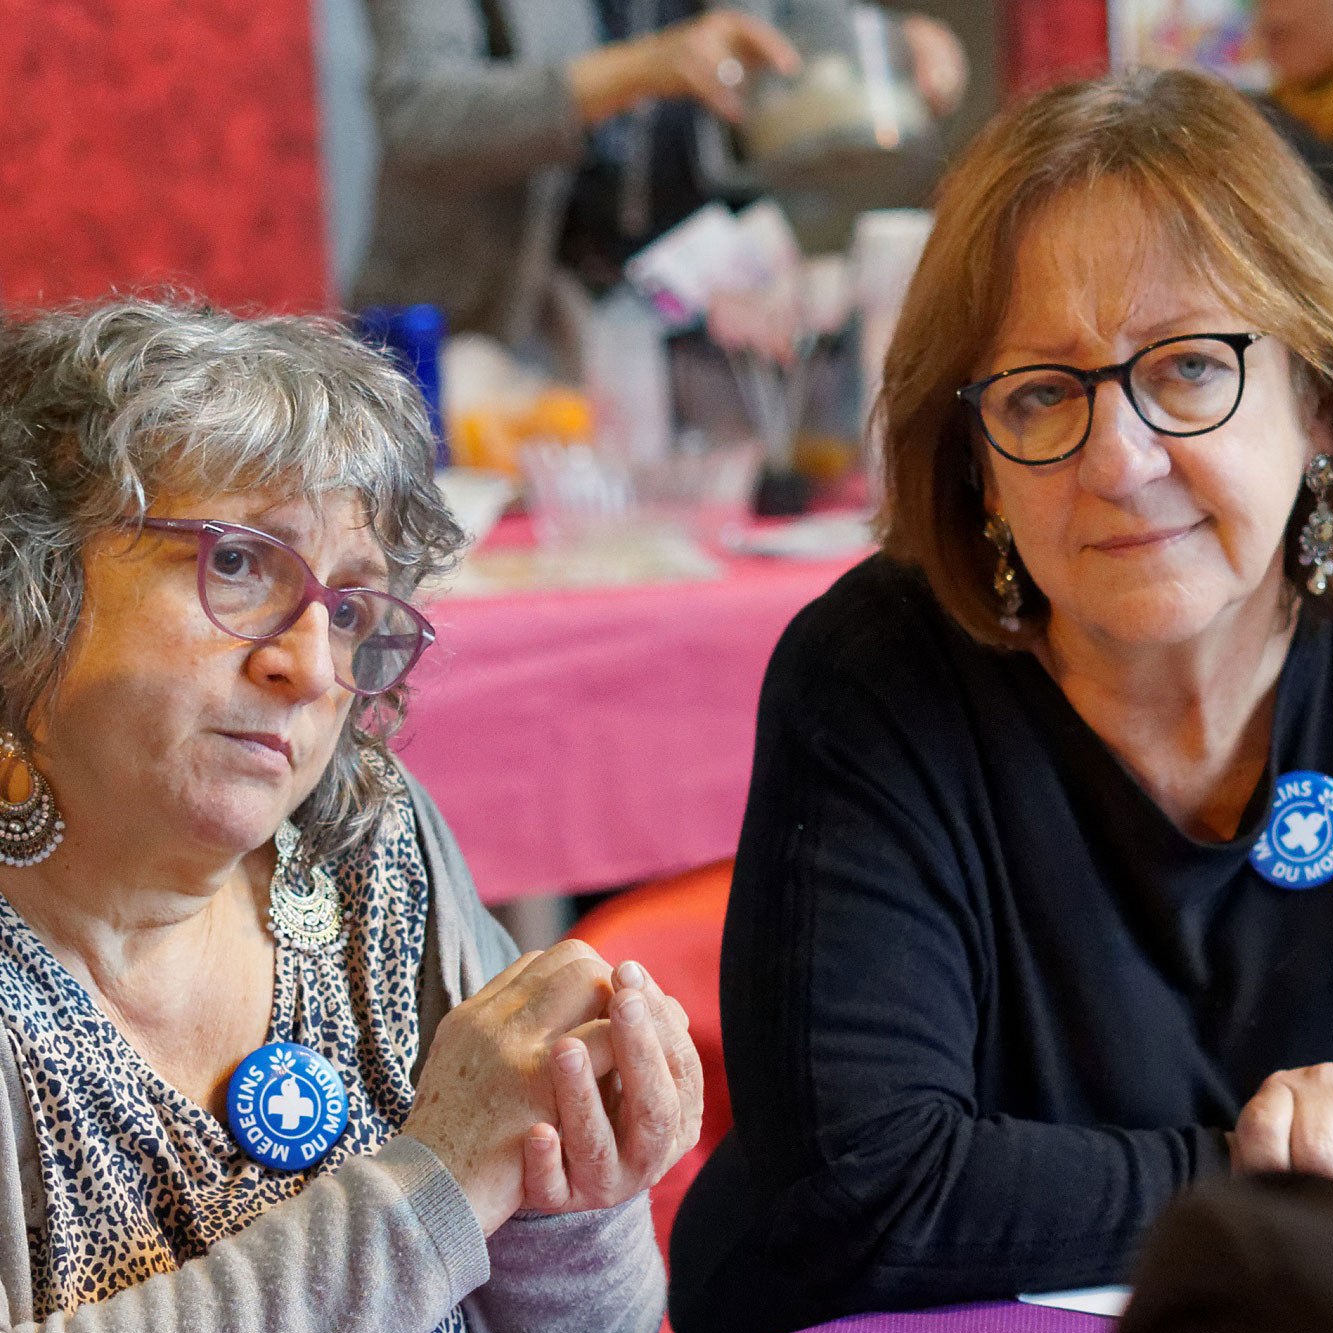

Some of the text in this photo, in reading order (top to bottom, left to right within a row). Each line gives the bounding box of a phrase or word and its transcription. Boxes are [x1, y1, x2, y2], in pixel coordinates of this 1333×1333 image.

[1271, 861, 1300, 882] DU
[236, 1058, 342, 1162] MÉDECINS DU MONDE
